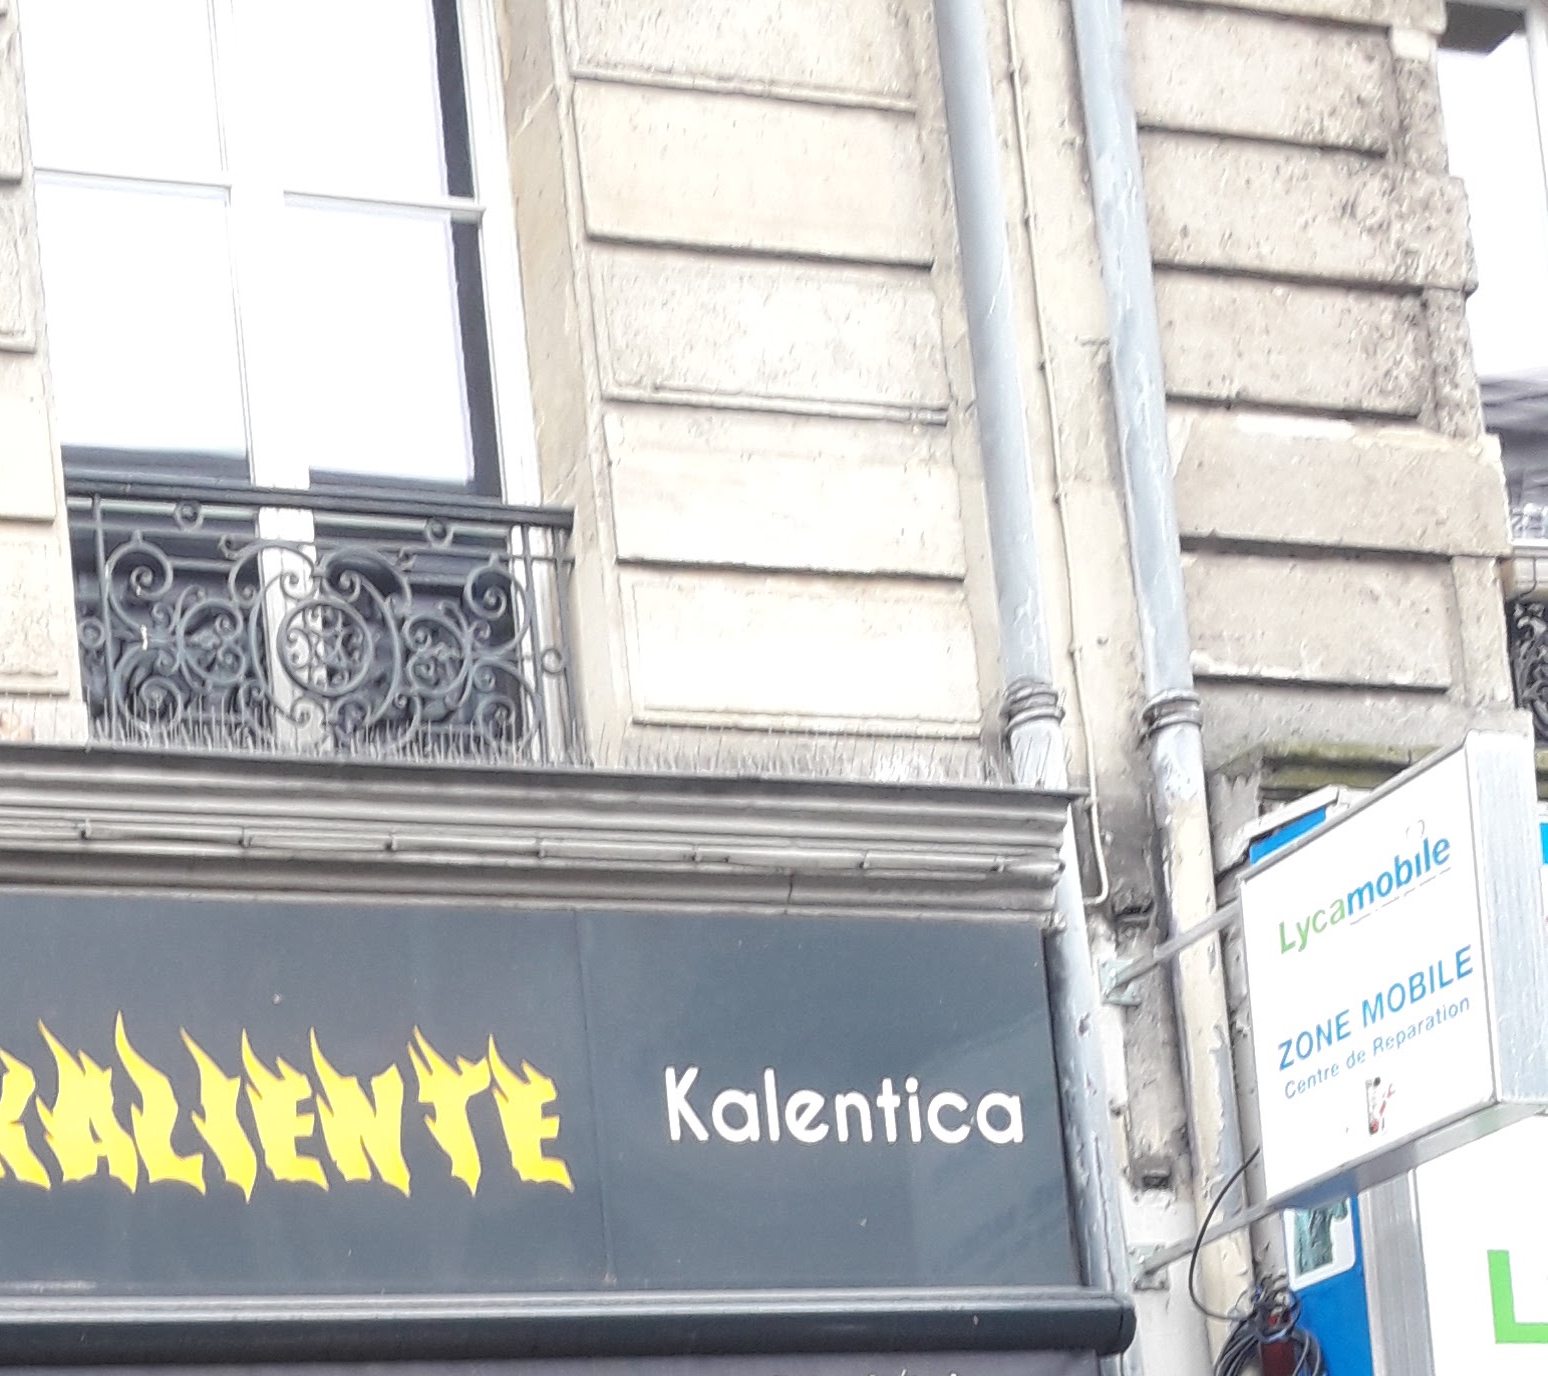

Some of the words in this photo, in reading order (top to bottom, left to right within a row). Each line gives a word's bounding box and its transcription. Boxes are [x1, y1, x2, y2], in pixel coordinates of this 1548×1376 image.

[1278, 837, 1451, 954] Lycamobile
[1277, 1008, 1352, 1071] ZONE
[1361, 944, 1474, 1028] MOBILE
[664, 1065, 1024, 1144] Kalentica
[1284, 1061, 1340, 1099] Centre
[1345, 1049, 1366, 1069] de
